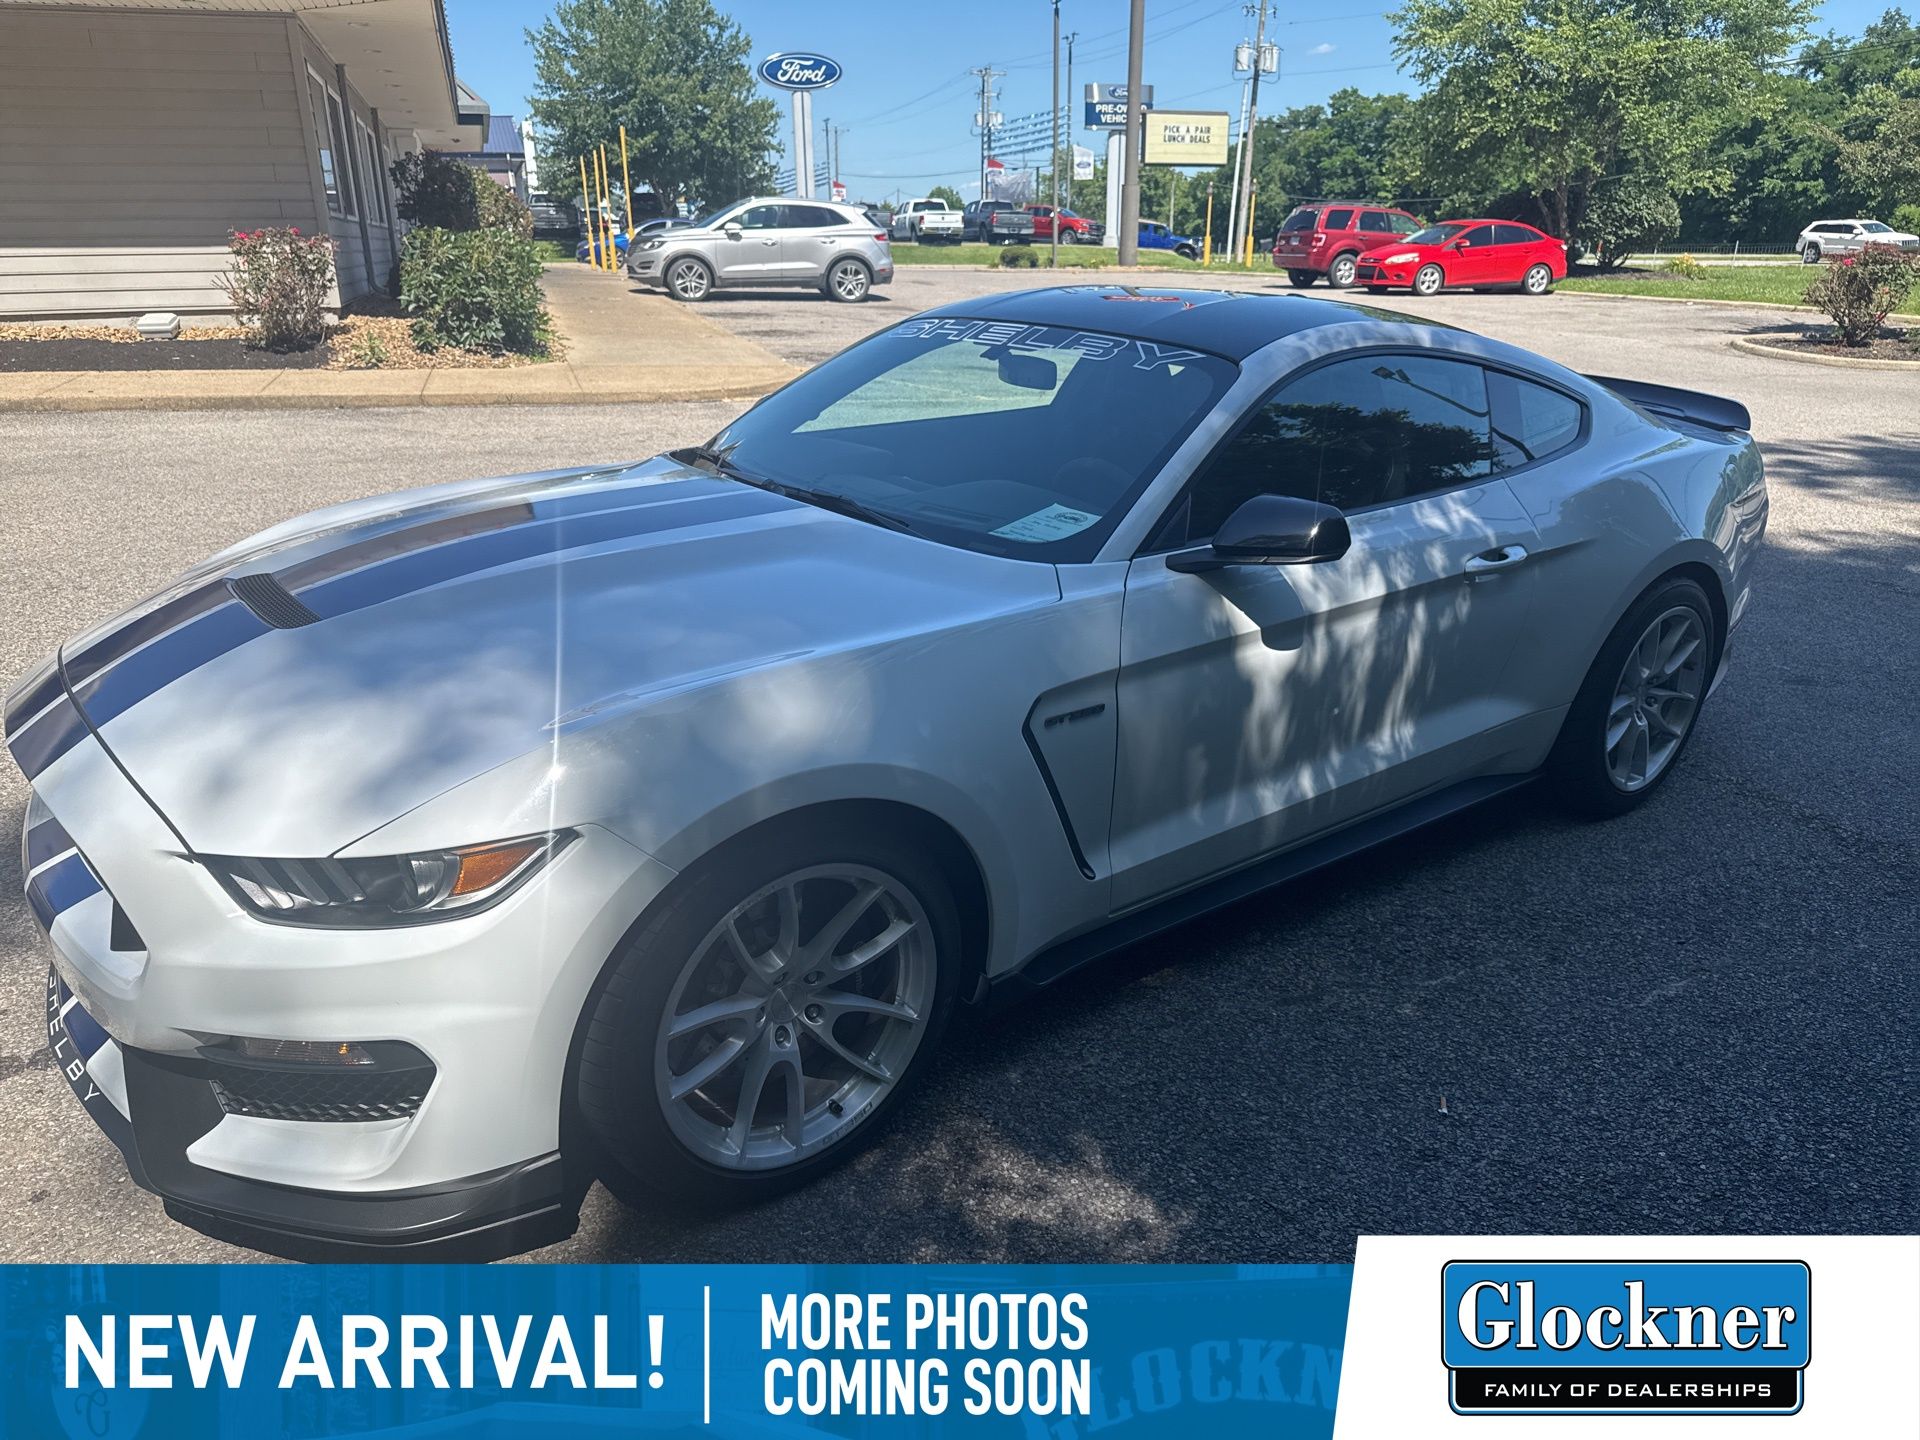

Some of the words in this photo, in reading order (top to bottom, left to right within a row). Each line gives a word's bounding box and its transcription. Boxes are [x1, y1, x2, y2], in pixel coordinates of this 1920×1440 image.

[777, 59, 826, 82] Ford
[1095, 104, 1147, 113] PRE-OWD
[1101, 114, 1142, 123] VEHICS
[1163, 125, 1180, 133] PICK
[1186, 126, 1190, 134] A
[1195, 126, 1211, 134] PAIR
[1163, 134, 1185, 143] LUNCH
[1190, 135, 1210, 143] DEALS
[888, 319, 1206, 371] SHELBY
